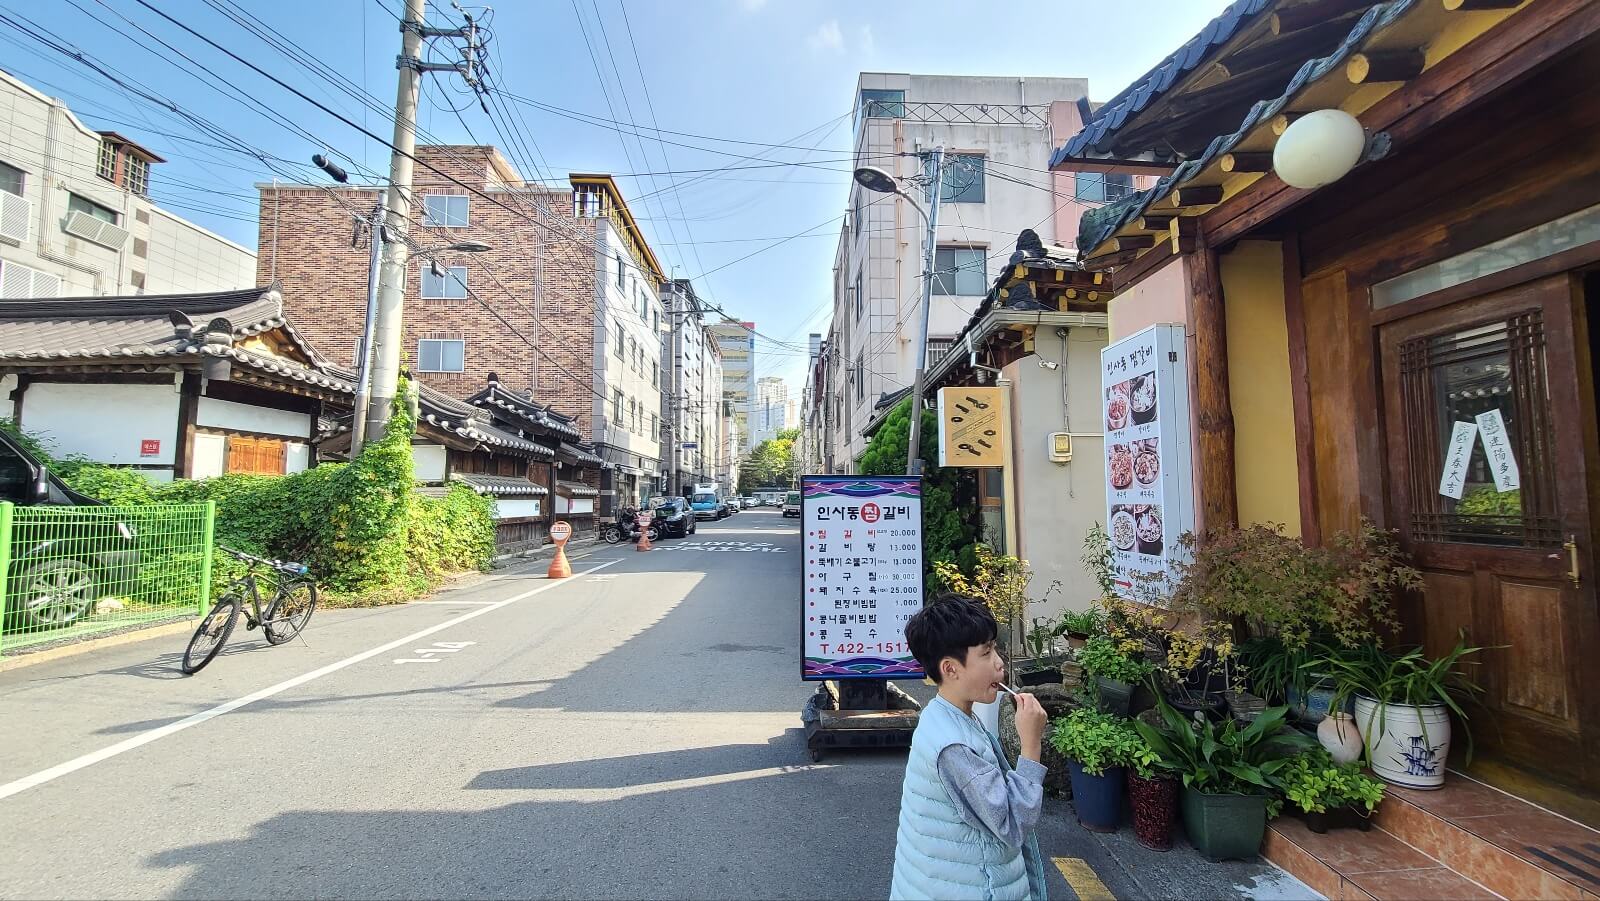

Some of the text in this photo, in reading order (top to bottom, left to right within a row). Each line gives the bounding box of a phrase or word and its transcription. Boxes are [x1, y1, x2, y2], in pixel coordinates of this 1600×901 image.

[1108, 346, 1152, 375] 인사동 찜갈비
[845, 557, 876, 566] 소불고기
